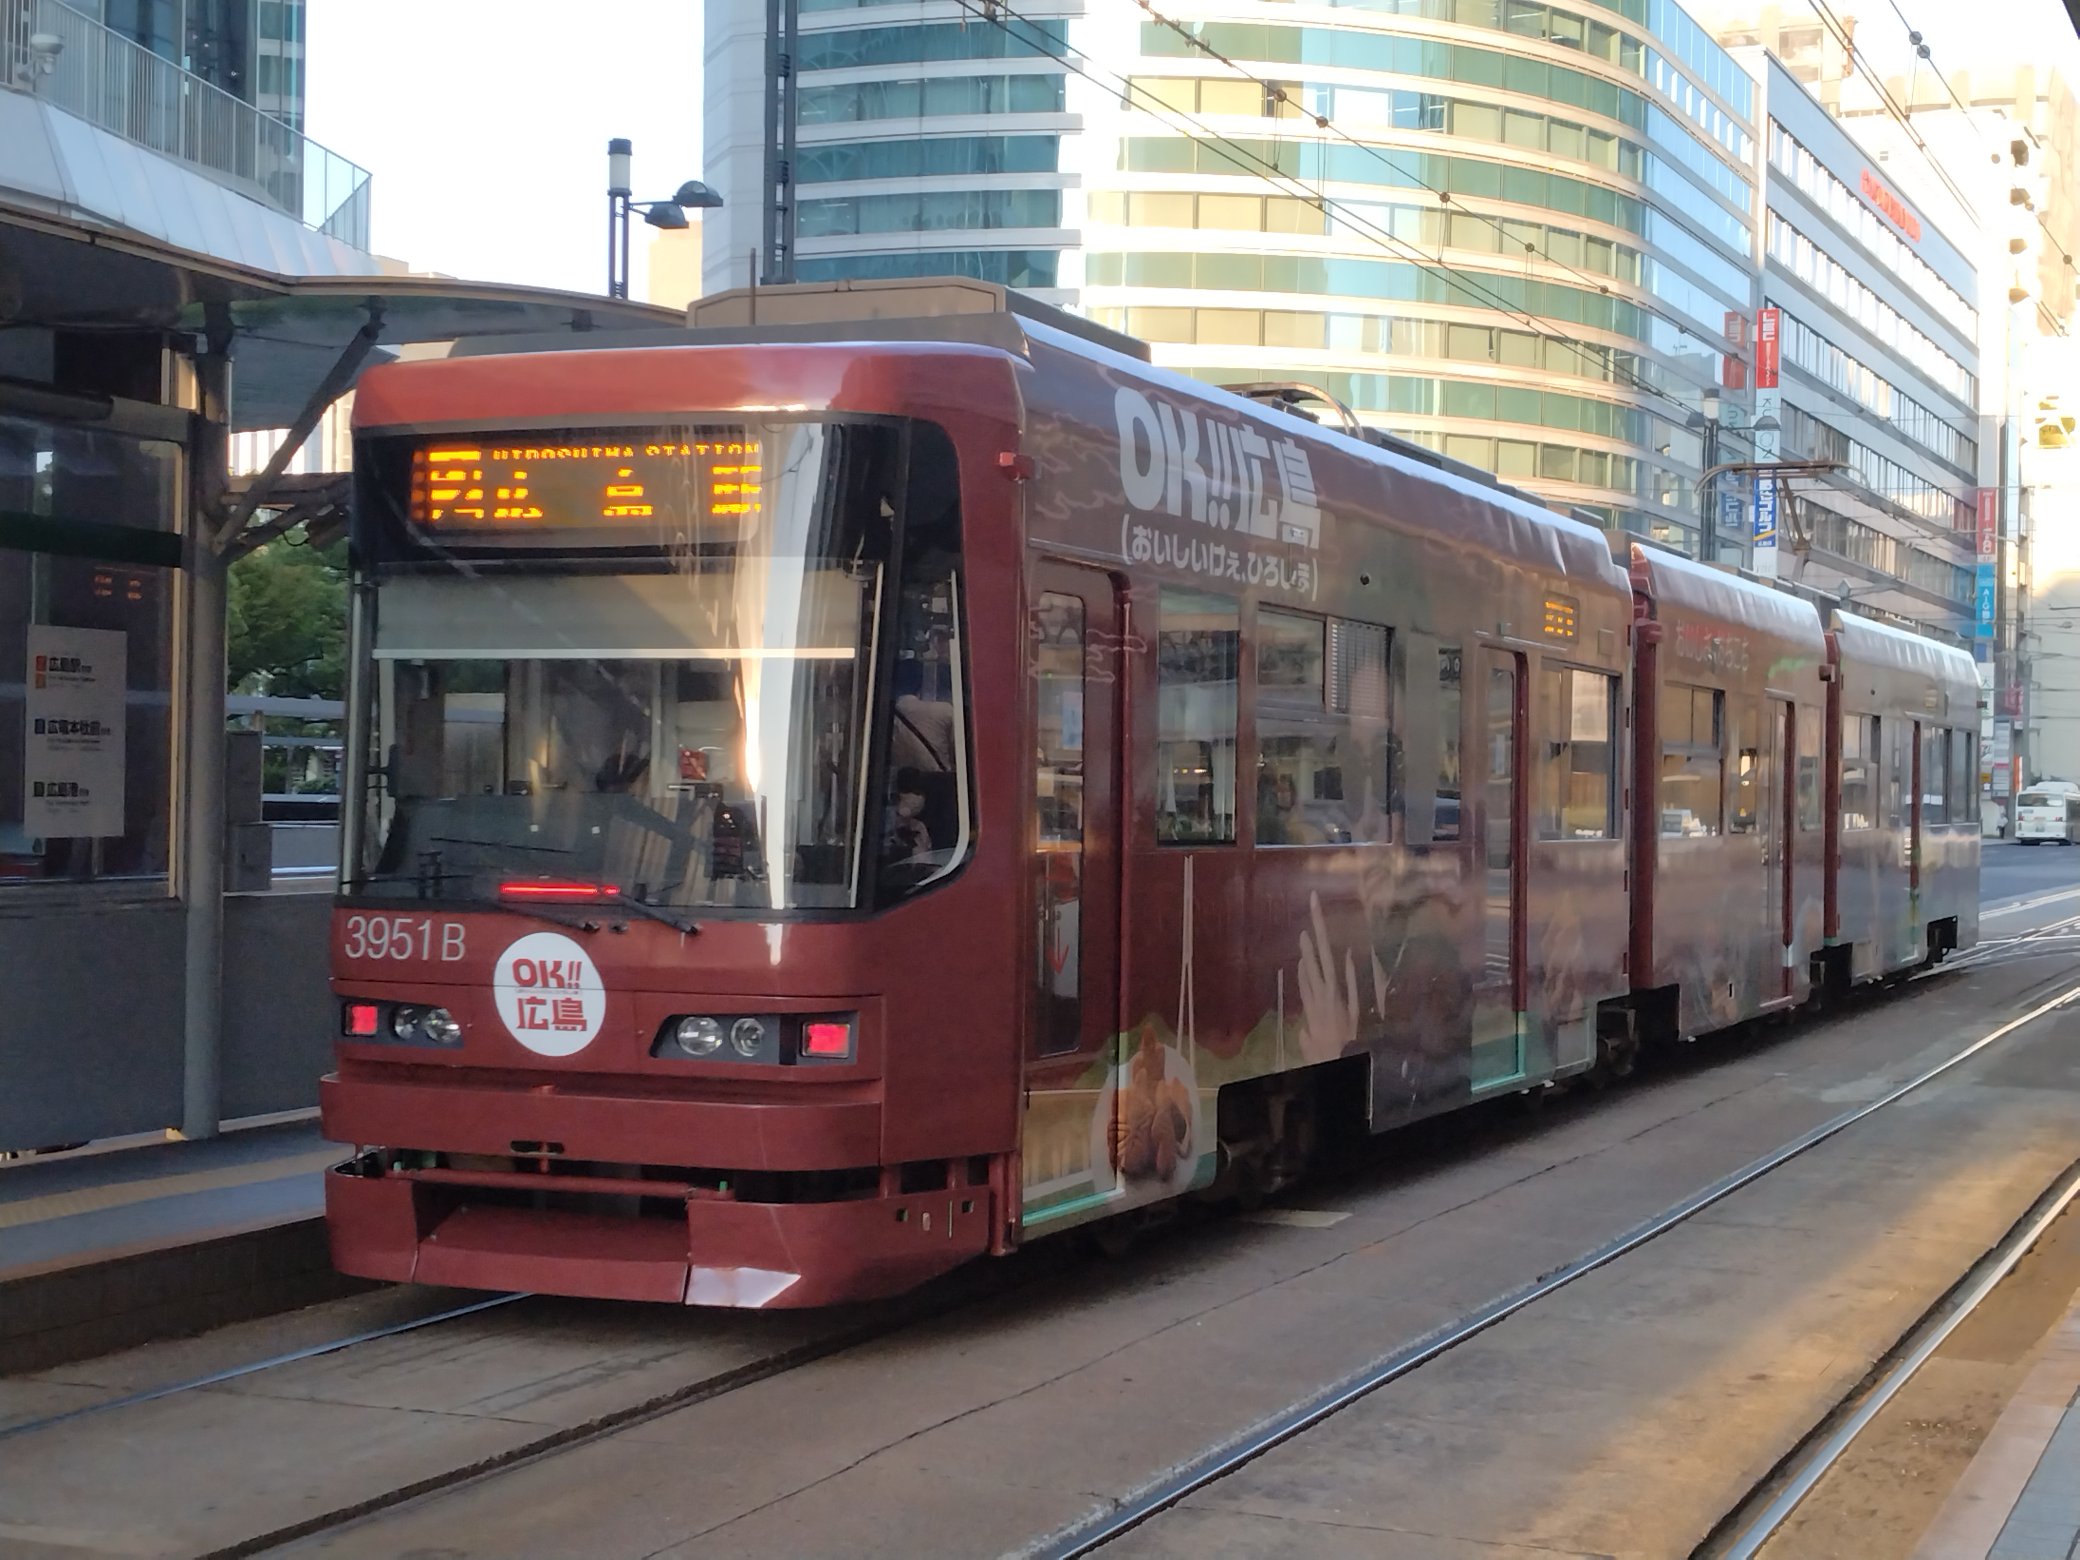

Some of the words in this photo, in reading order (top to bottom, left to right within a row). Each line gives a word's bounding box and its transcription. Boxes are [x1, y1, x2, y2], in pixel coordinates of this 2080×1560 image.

[1115, 386, 1321, 549] OK!!広島
[512, 958, 582, 989] OK!!
[516, 996, 587, 1031] 広島
